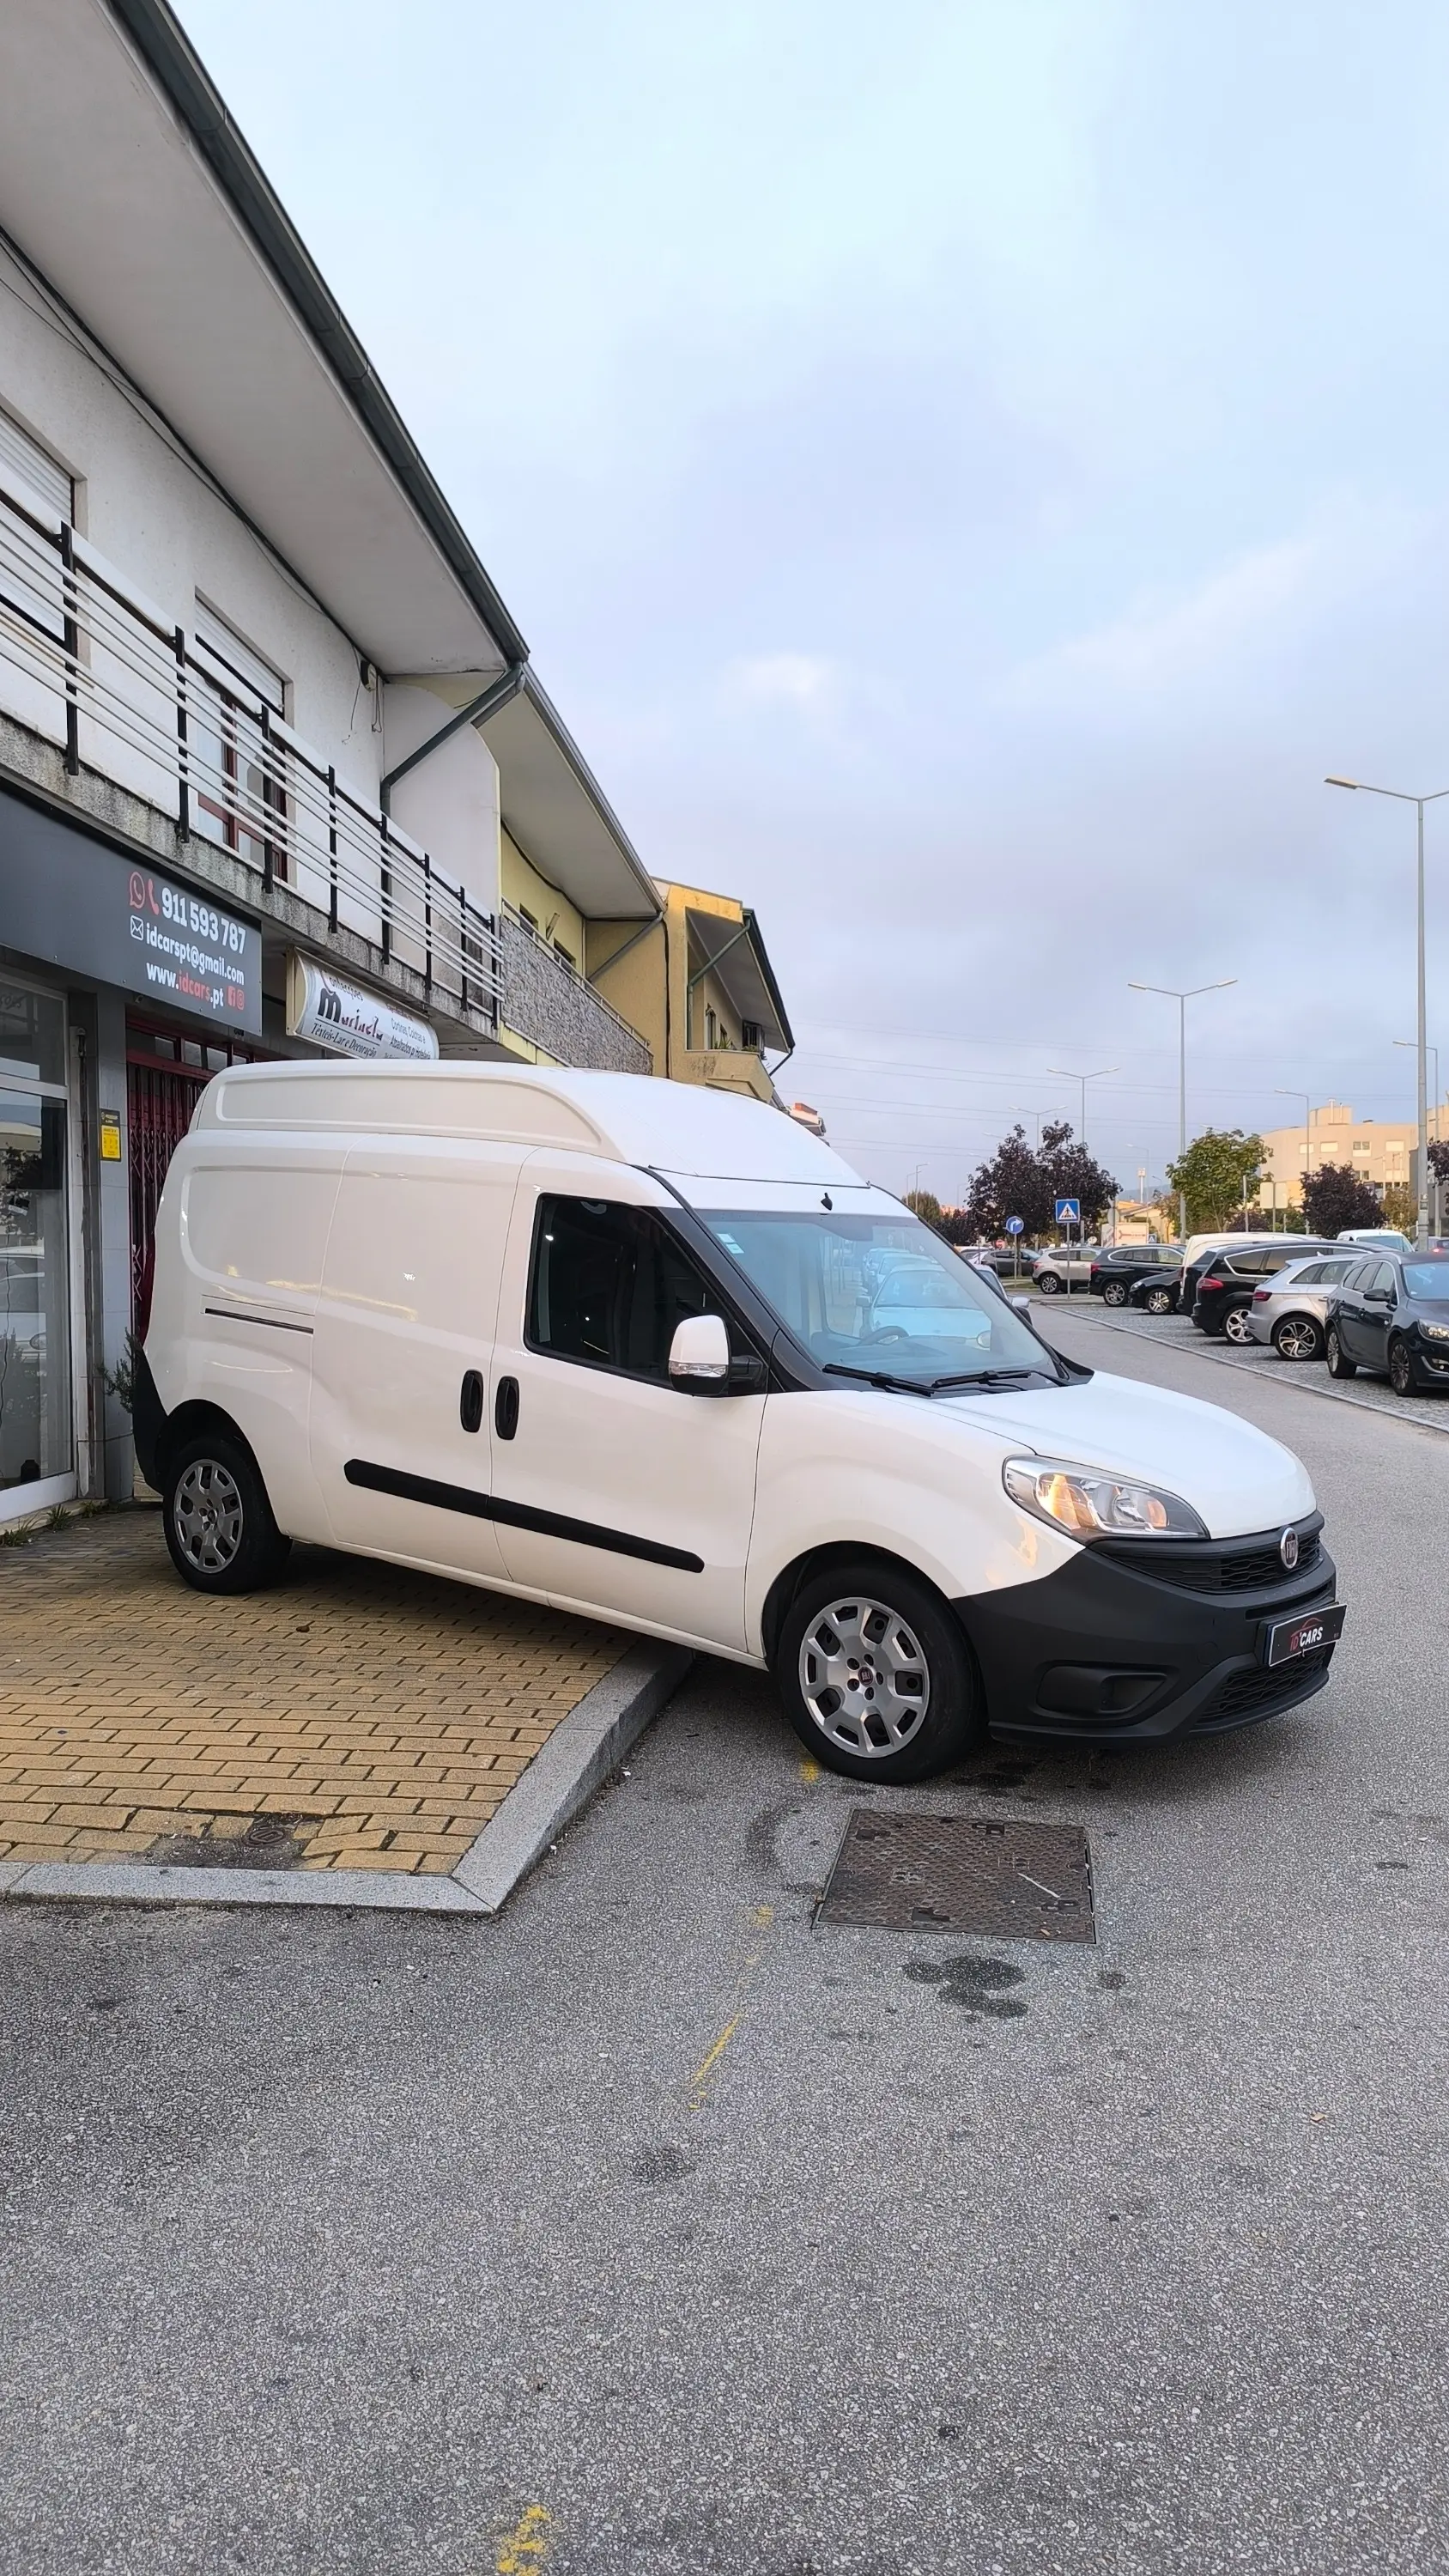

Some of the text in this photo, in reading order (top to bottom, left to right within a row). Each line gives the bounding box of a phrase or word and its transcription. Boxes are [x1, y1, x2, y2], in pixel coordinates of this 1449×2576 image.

[161, 887, 246, 955] 911 593 787
[146, 922, 245, 986] idcarspt@gmail.com
[146, 962, 224, 1009] www.idcars.pt
